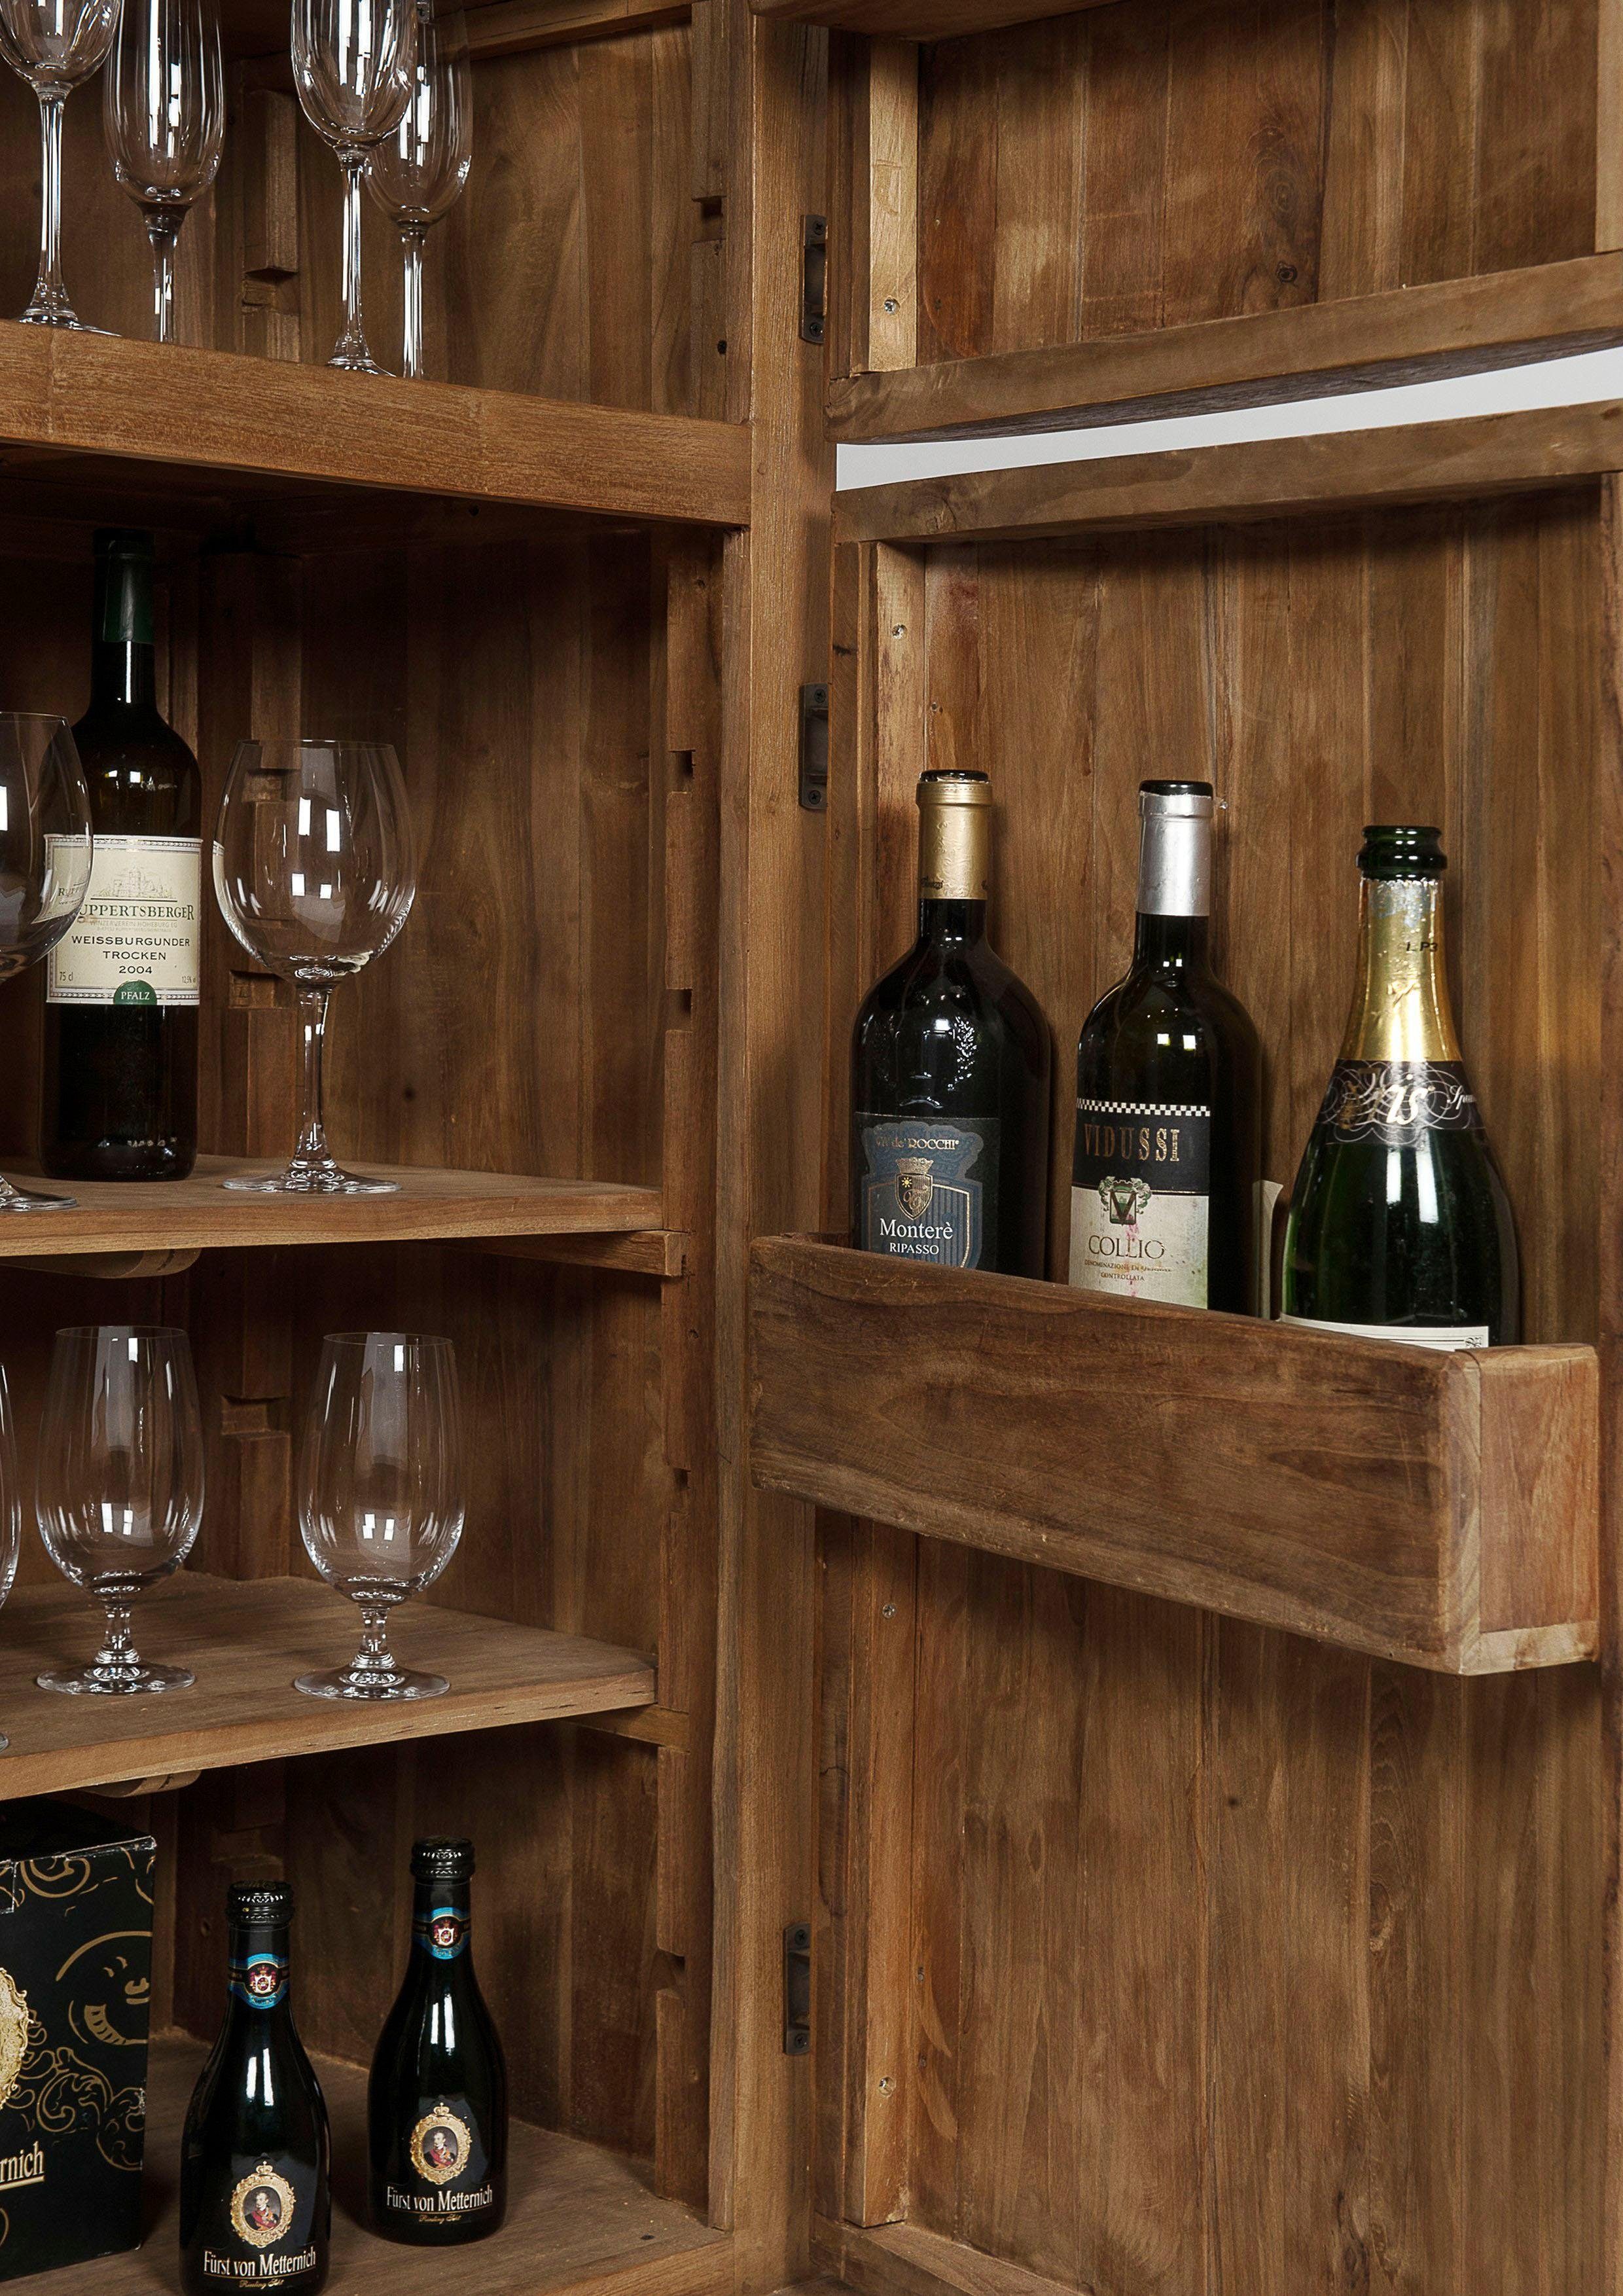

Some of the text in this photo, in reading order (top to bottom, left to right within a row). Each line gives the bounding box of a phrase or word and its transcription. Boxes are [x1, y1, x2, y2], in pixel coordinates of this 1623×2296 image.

[71, 935, 190, 946] WEISSBURGUNDER
[103, 951, 166, 960] TROCKEN
[118, 965, 152, 974] 2004
[60, 971, 66, 981] 75
[121, 992, 151, 1000] PFALZ
[1084, 1123, 1180, 1162] VIDUSSI
[880, 1218, 954, 1239] Monterè
[889, 1242, 939, 1255] RIPASSO
[1088, 1234, 1167, 1259] COLLIO
[1101, 1272, 1145, 1282] CONTROLLATA
[387, 2184, 493, 2212] Fürst von Metternich
[204, 2246, 316, 2276] Fürst von Metternich
